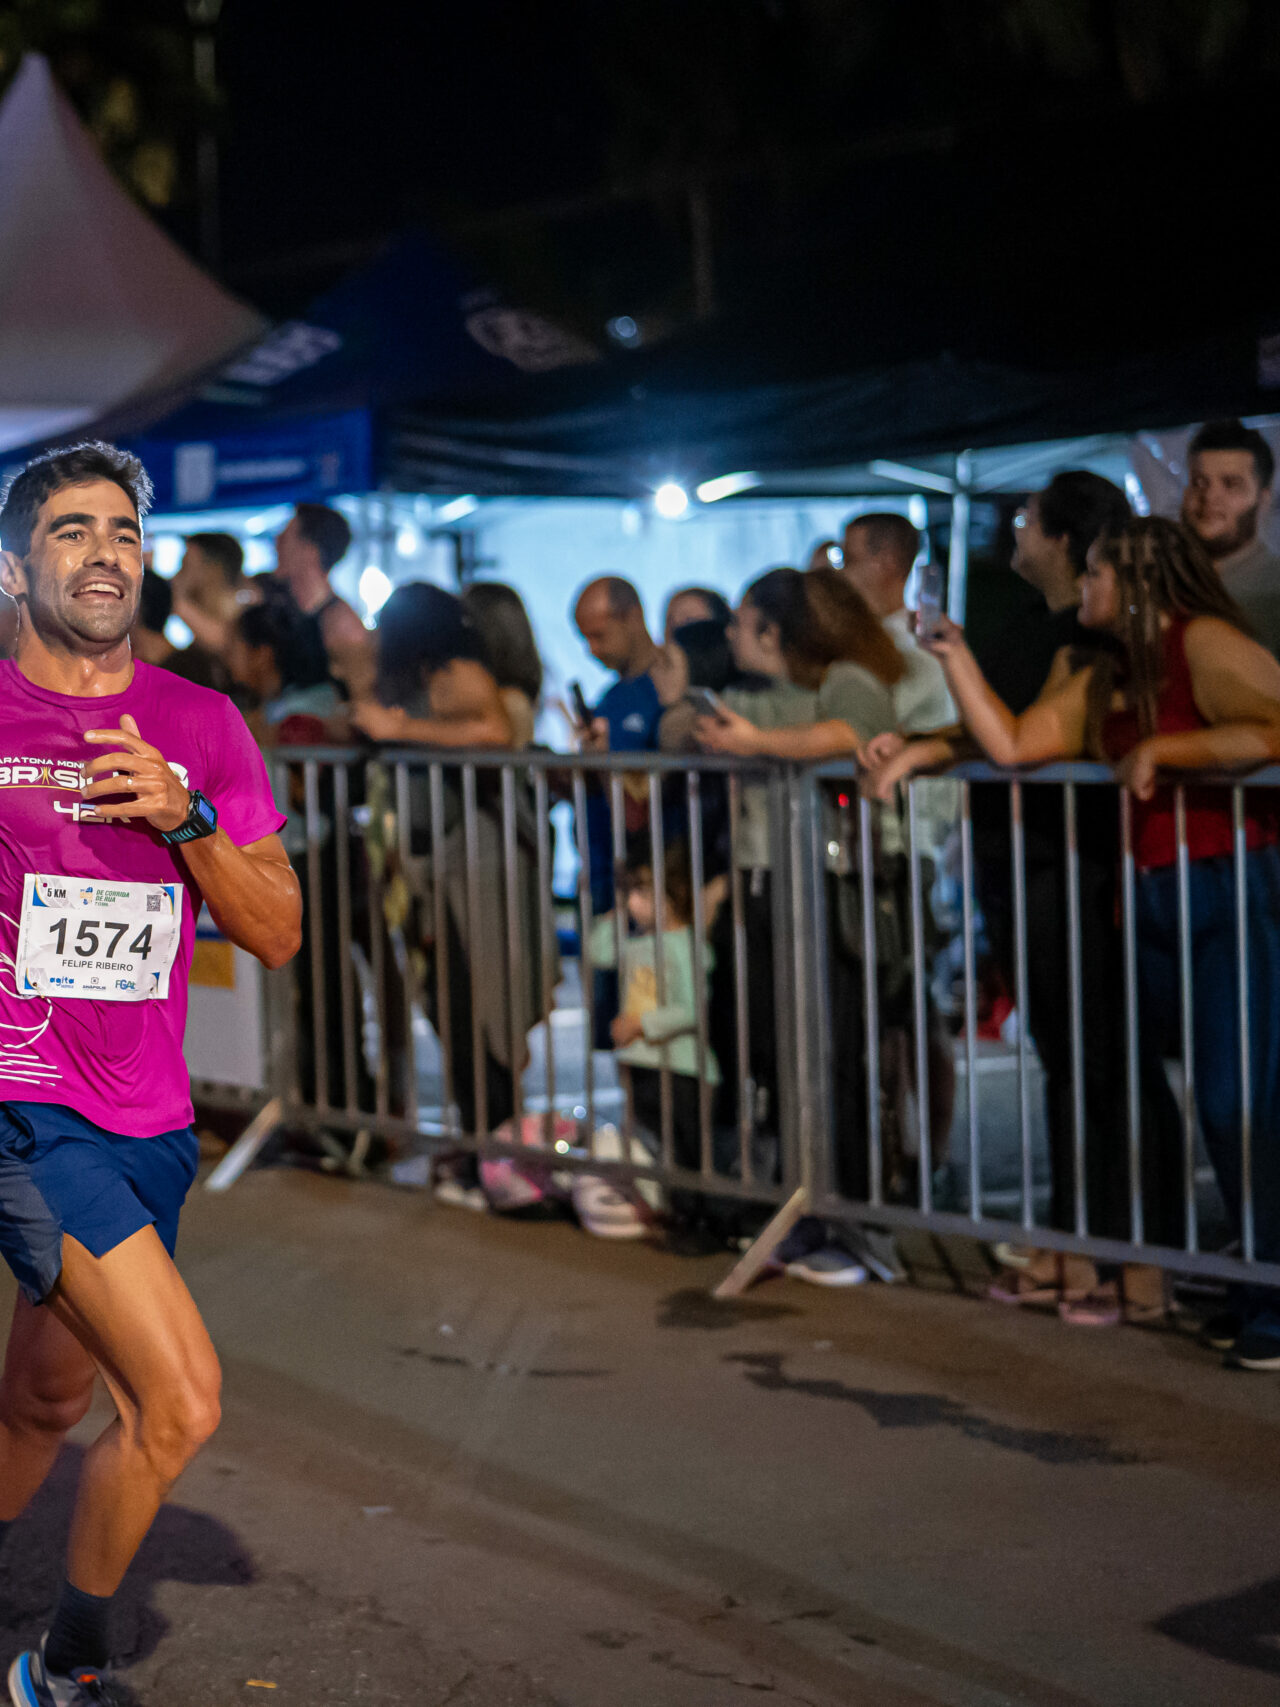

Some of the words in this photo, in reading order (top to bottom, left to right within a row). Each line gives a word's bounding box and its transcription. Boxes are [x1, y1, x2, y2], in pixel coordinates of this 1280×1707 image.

[47, 887, 53, 897] 5
[54, 888, 66, 898] KM
[105, 890, 130, 898] CORRIDA
[49, 917, 153, 961] 1574
[62, 959, 93, 969] FELIPE
[95, 961, 134, 972] RIBEIRO
